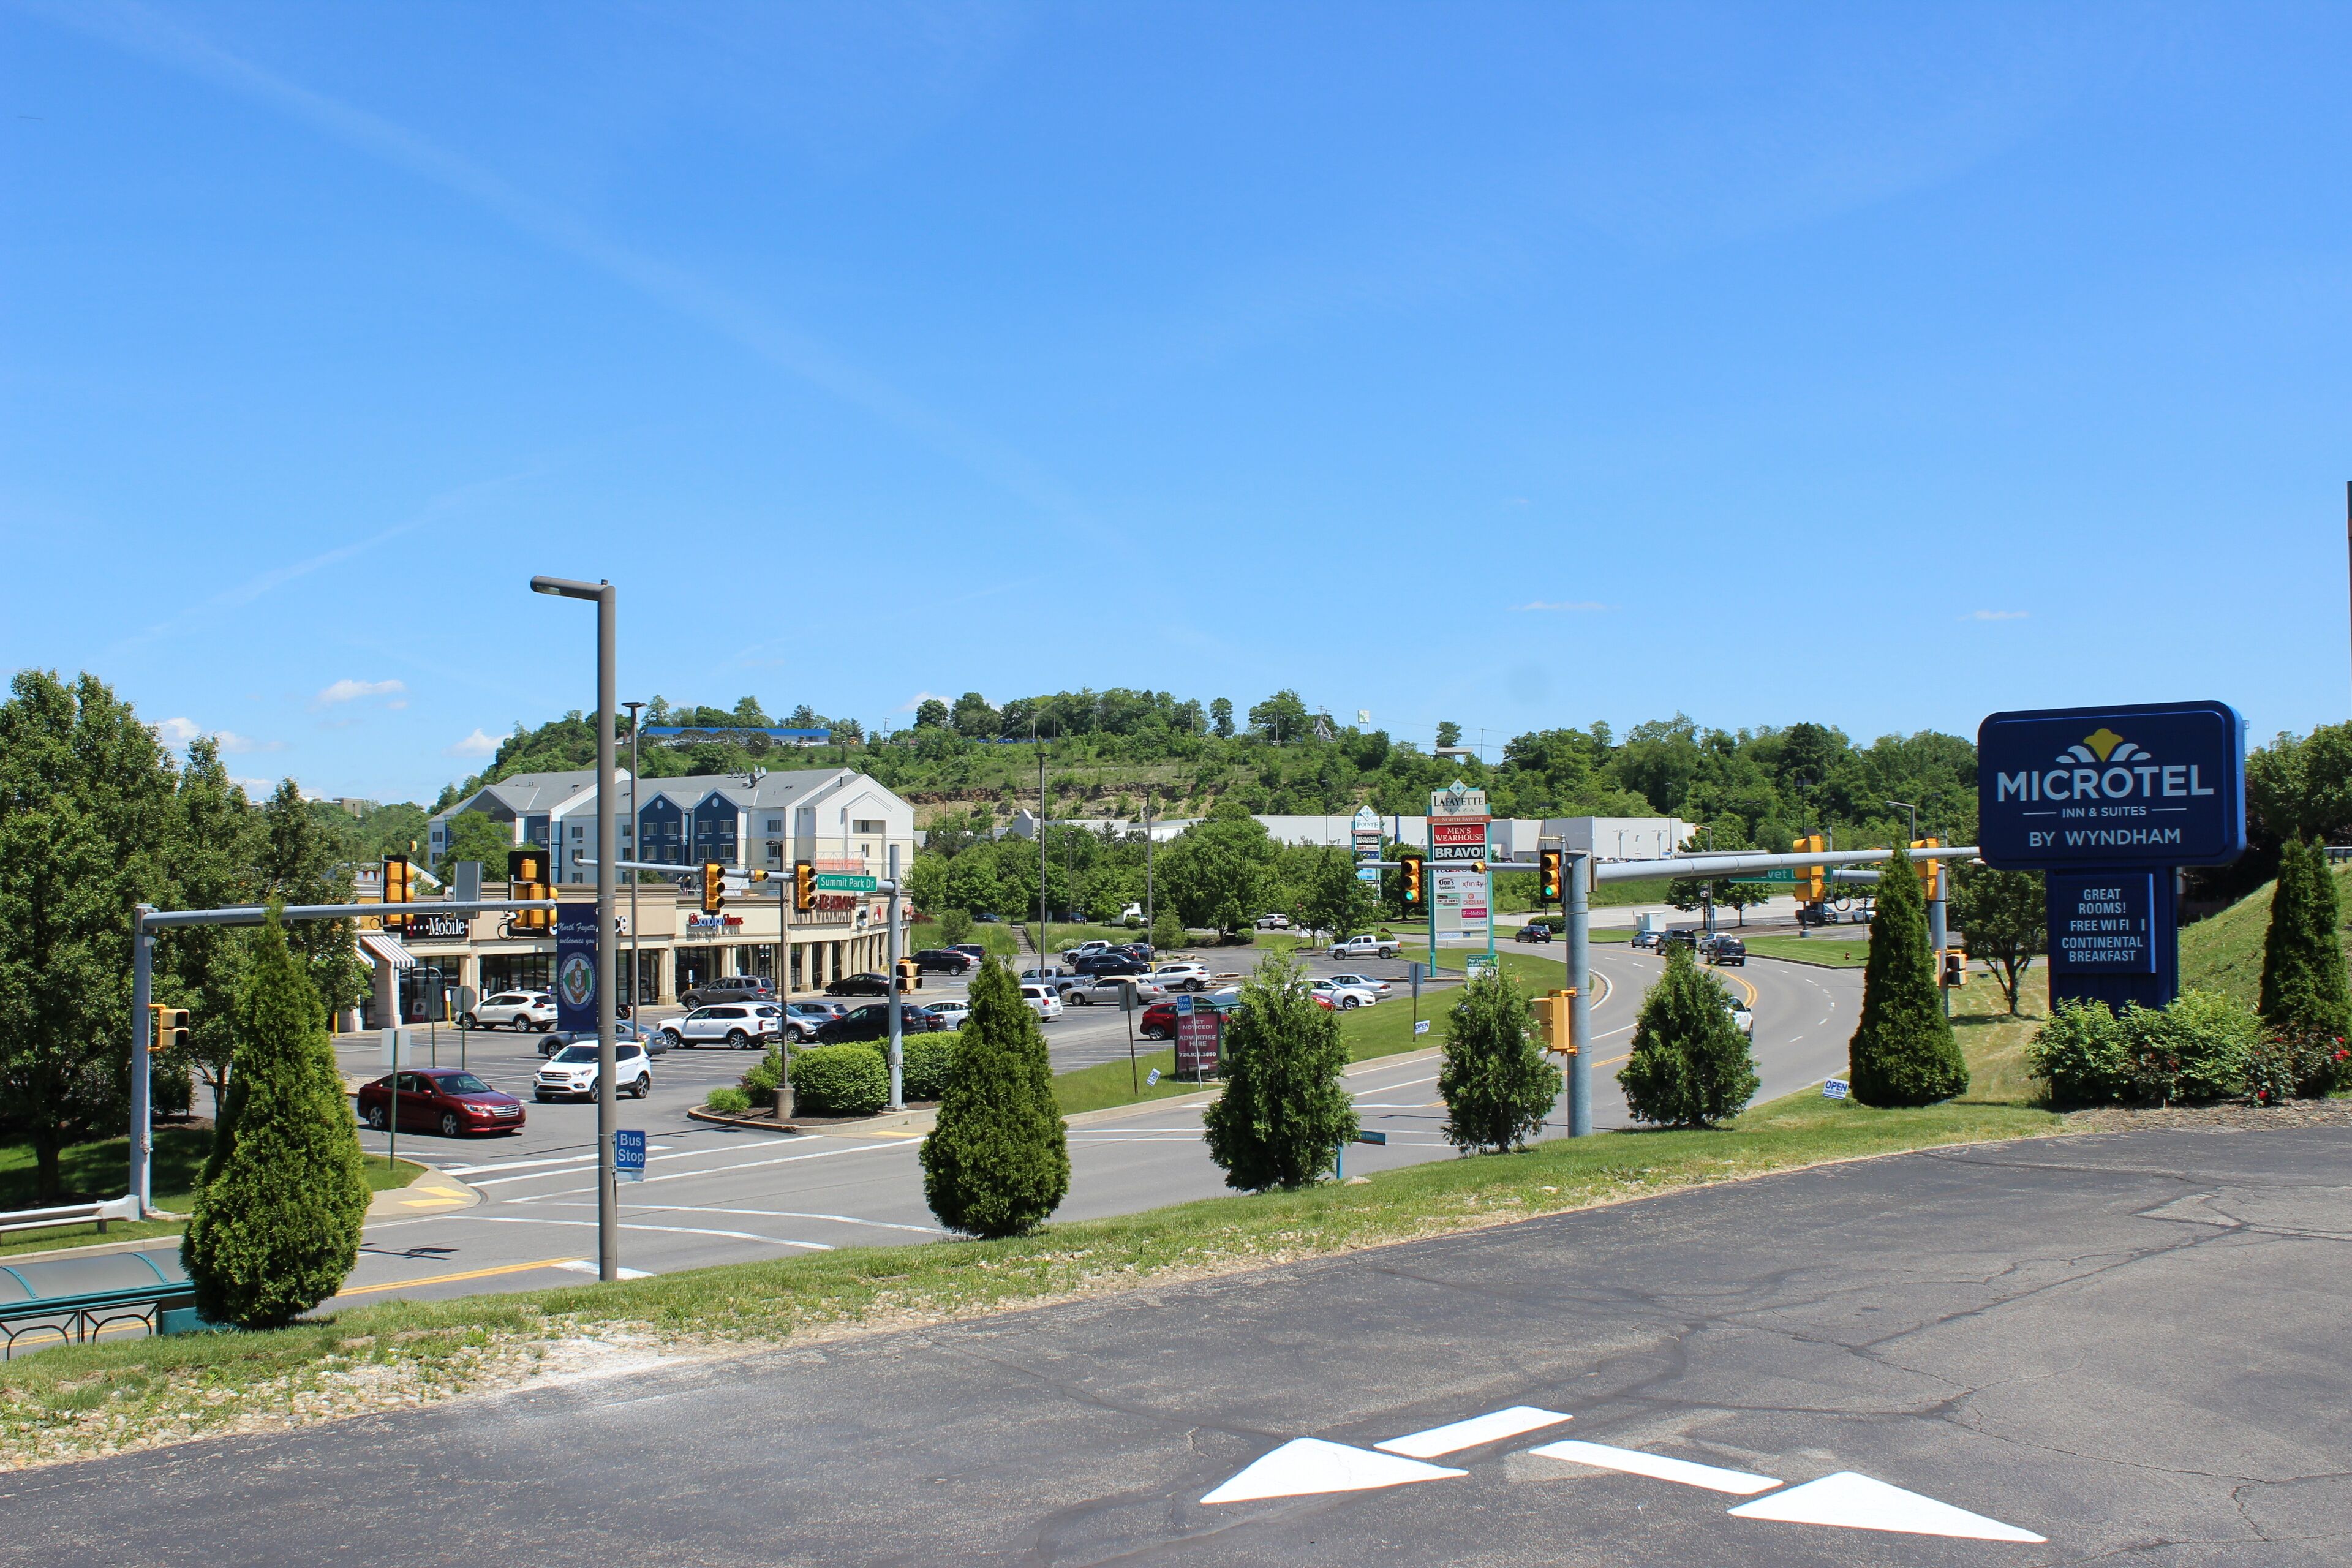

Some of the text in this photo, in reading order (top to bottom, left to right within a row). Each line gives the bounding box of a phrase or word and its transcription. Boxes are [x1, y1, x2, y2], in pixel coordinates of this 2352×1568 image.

[1997, 764, 2214, 802] MICROTEL
[1434, 796, 1483, 806] LAFAYETTE
[2062, 806, 2147, 818] INN & SUITES
[2029, 828, 2181, 847] BY WYNDHAM
[1435, 847, 1484, 858] BRAVO!
[821, 876, 874, 888] Summit Park Dr
[2083, 889, 2121, 900] GREAT
[2078, 902, 2127, 914] ROOMS!
[558, 922, 596, 932] North Fayette
[2070, 920, 2098, 932] FREE
[2062, 936, 2144, 949] CONTINENTAL
[2069, 950, 2136, 962] BREAKFAST
[1825, 1080, 1848, 1092] OPEN
[620, 1134, 642, 1146] Bus
[618, 1148, 644, 1164] Stop
